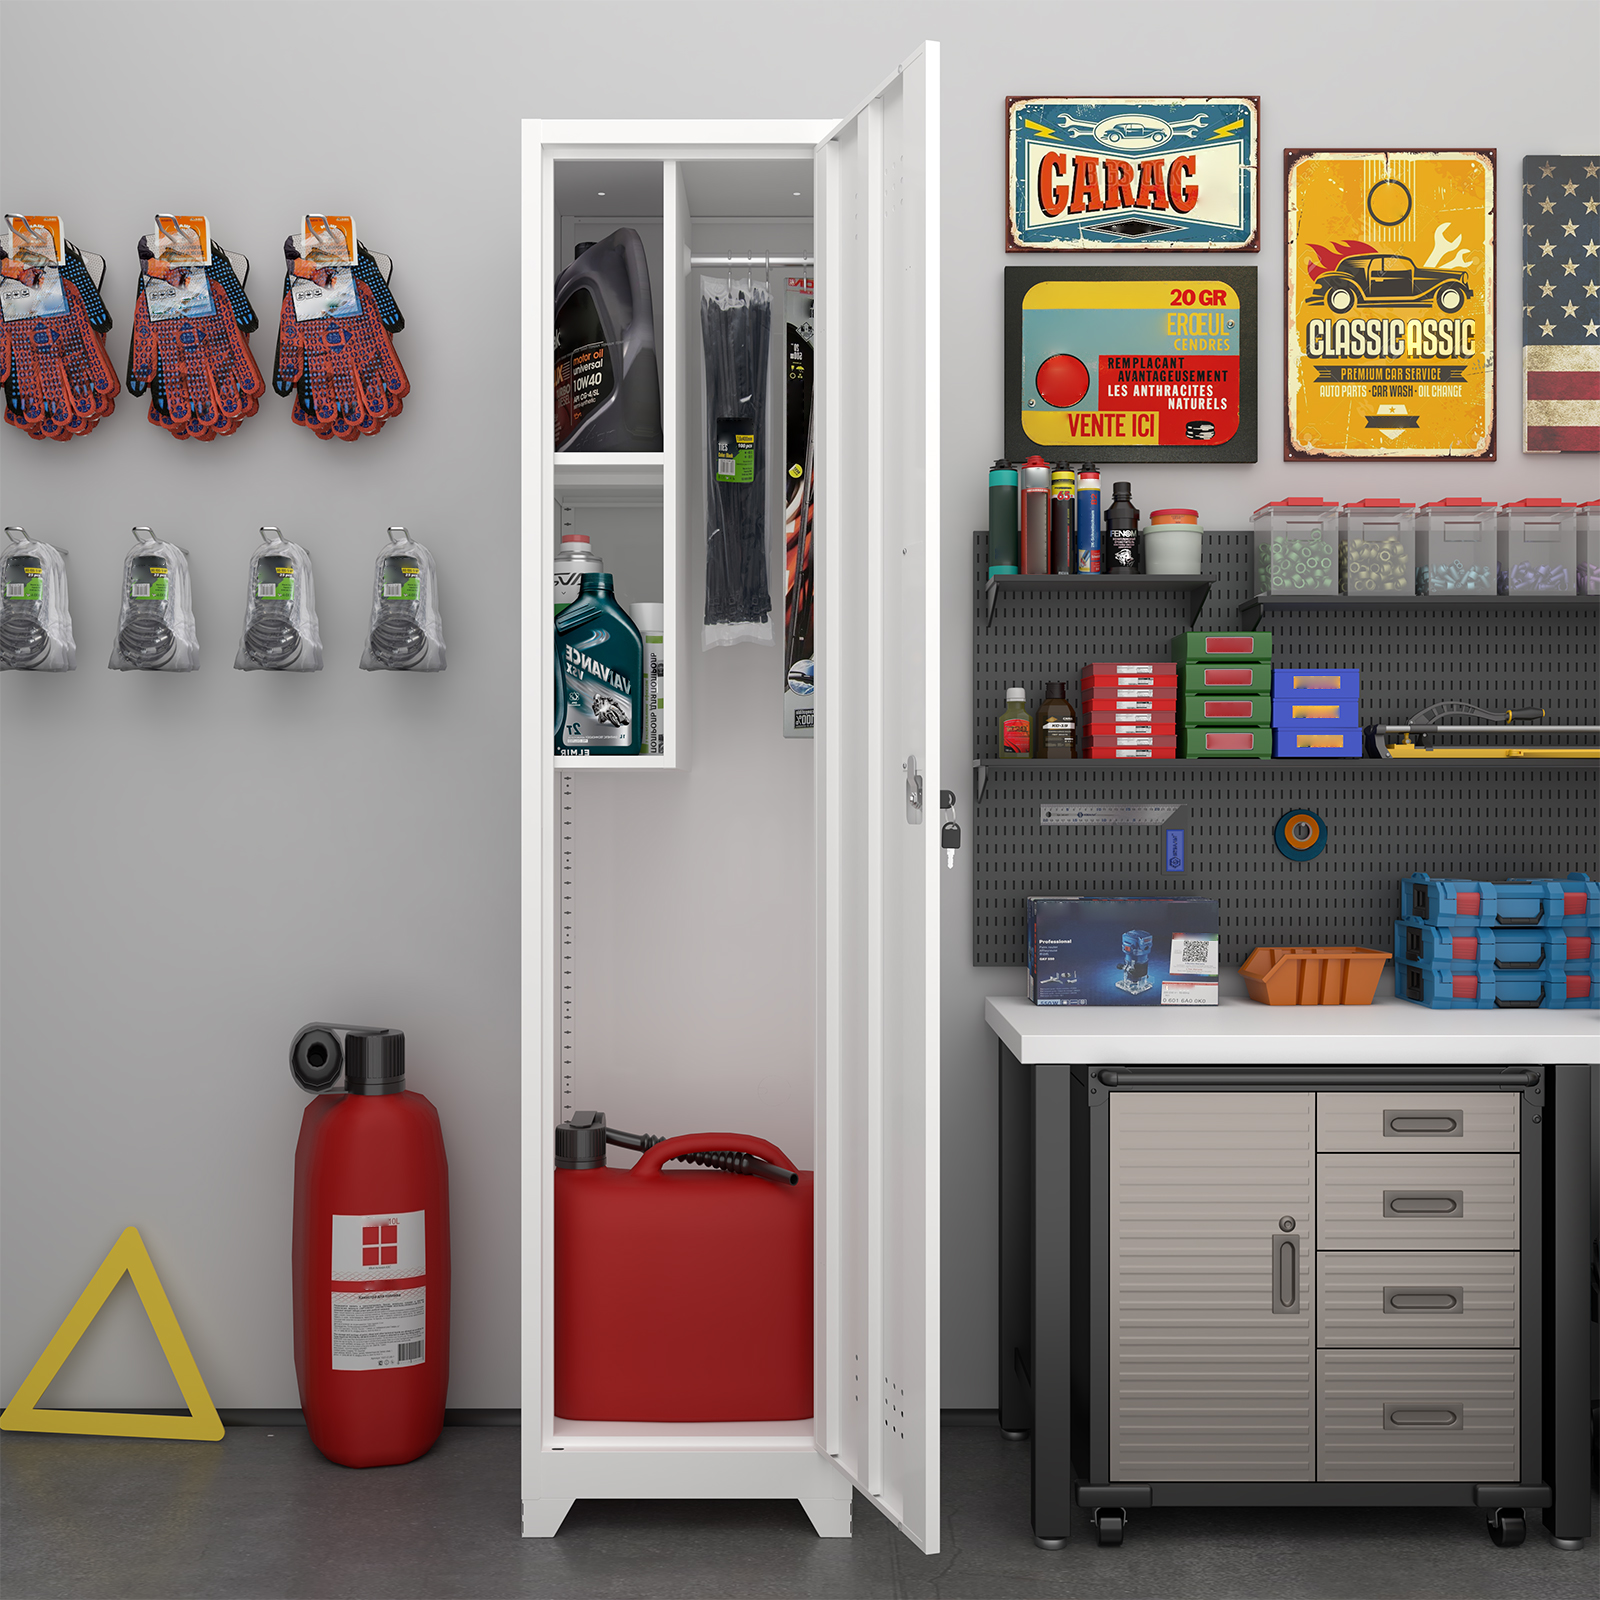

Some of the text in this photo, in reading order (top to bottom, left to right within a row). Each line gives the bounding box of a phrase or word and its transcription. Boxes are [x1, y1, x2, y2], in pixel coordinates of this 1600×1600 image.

[1170, 289, 1227, 306] 20 GR
[1174, 338, 1230, 351] CENDRES
[573, 348, 604, 367] motor oil
[1107, 357, 1185, 370] REMPLAÇANT
[573, 358, 603, 376] universal
[1117, 370, 1228, 382] AVANTAGEUSEMENT
[1341, 367, 1441, 381] PREMIUM CAR SERVICE
[573, 372, 602, 392] 10W40
[1107, 385, 1213, 397] LES ANTHRACITES
[1320, 385, 1463, 398] AUTO PARTS CAR WASH OIL CHANGE
[1168, 398, 1228, 410] NATURELS
[1068, 413, 1155, 437] VENTE ICI
[1090, 493, 1097, 505] B2
